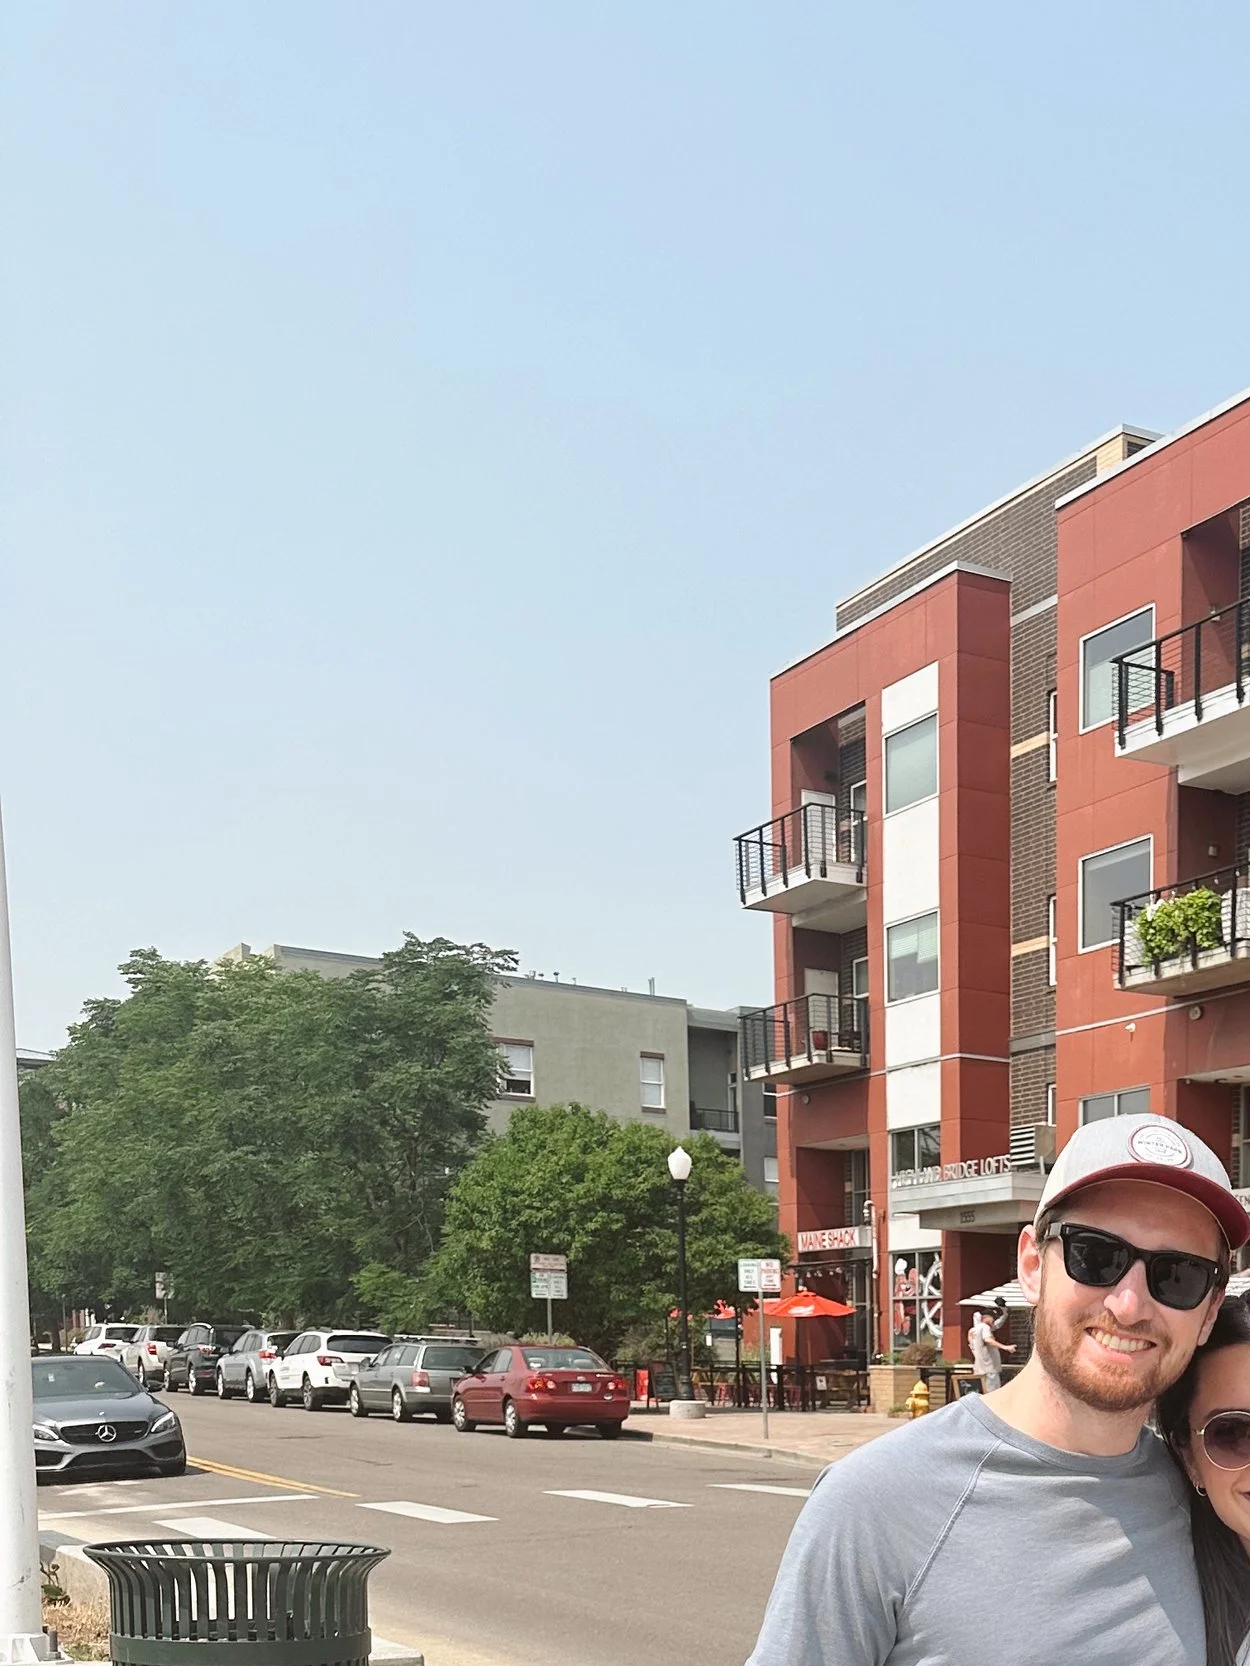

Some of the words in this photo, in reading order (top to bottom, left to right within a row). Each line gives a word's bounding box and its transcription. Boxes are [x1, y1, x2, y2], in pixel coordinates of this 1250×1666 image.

[943, 1159, 979, 1181] BRIDGE
[979, 1154, 1011, 1176] LOFTS
[801, 1231, 826, 1249] MAINE
[827, 1228, 857, 1248] SHACK
